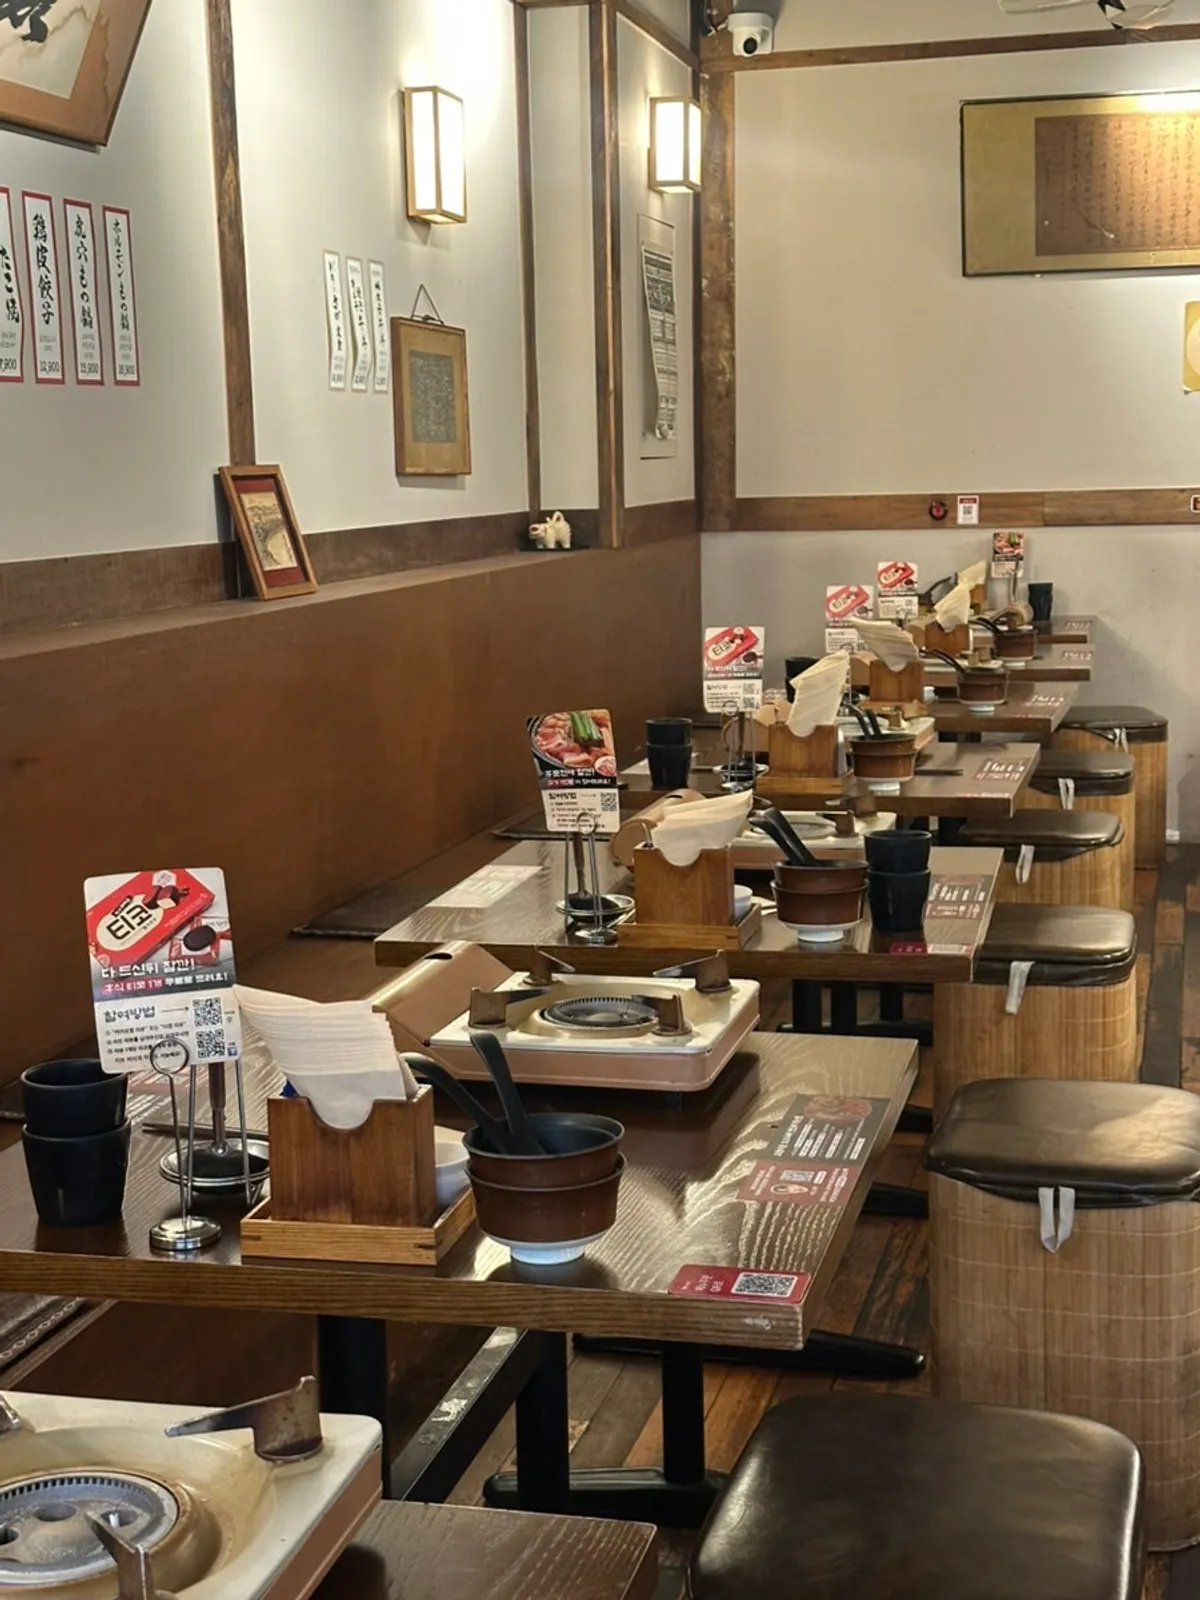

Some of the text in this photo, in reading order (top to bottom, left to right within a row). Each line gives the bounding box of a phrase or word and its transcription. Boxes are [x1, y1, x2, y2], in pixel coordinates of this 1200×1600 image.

[106, 904, 152, 940] 티코
[101, 968, 116, 979] 다
[162, 958, 195, 974] 잠깐!
[103, 1005, 156, 1022] 참여방법
